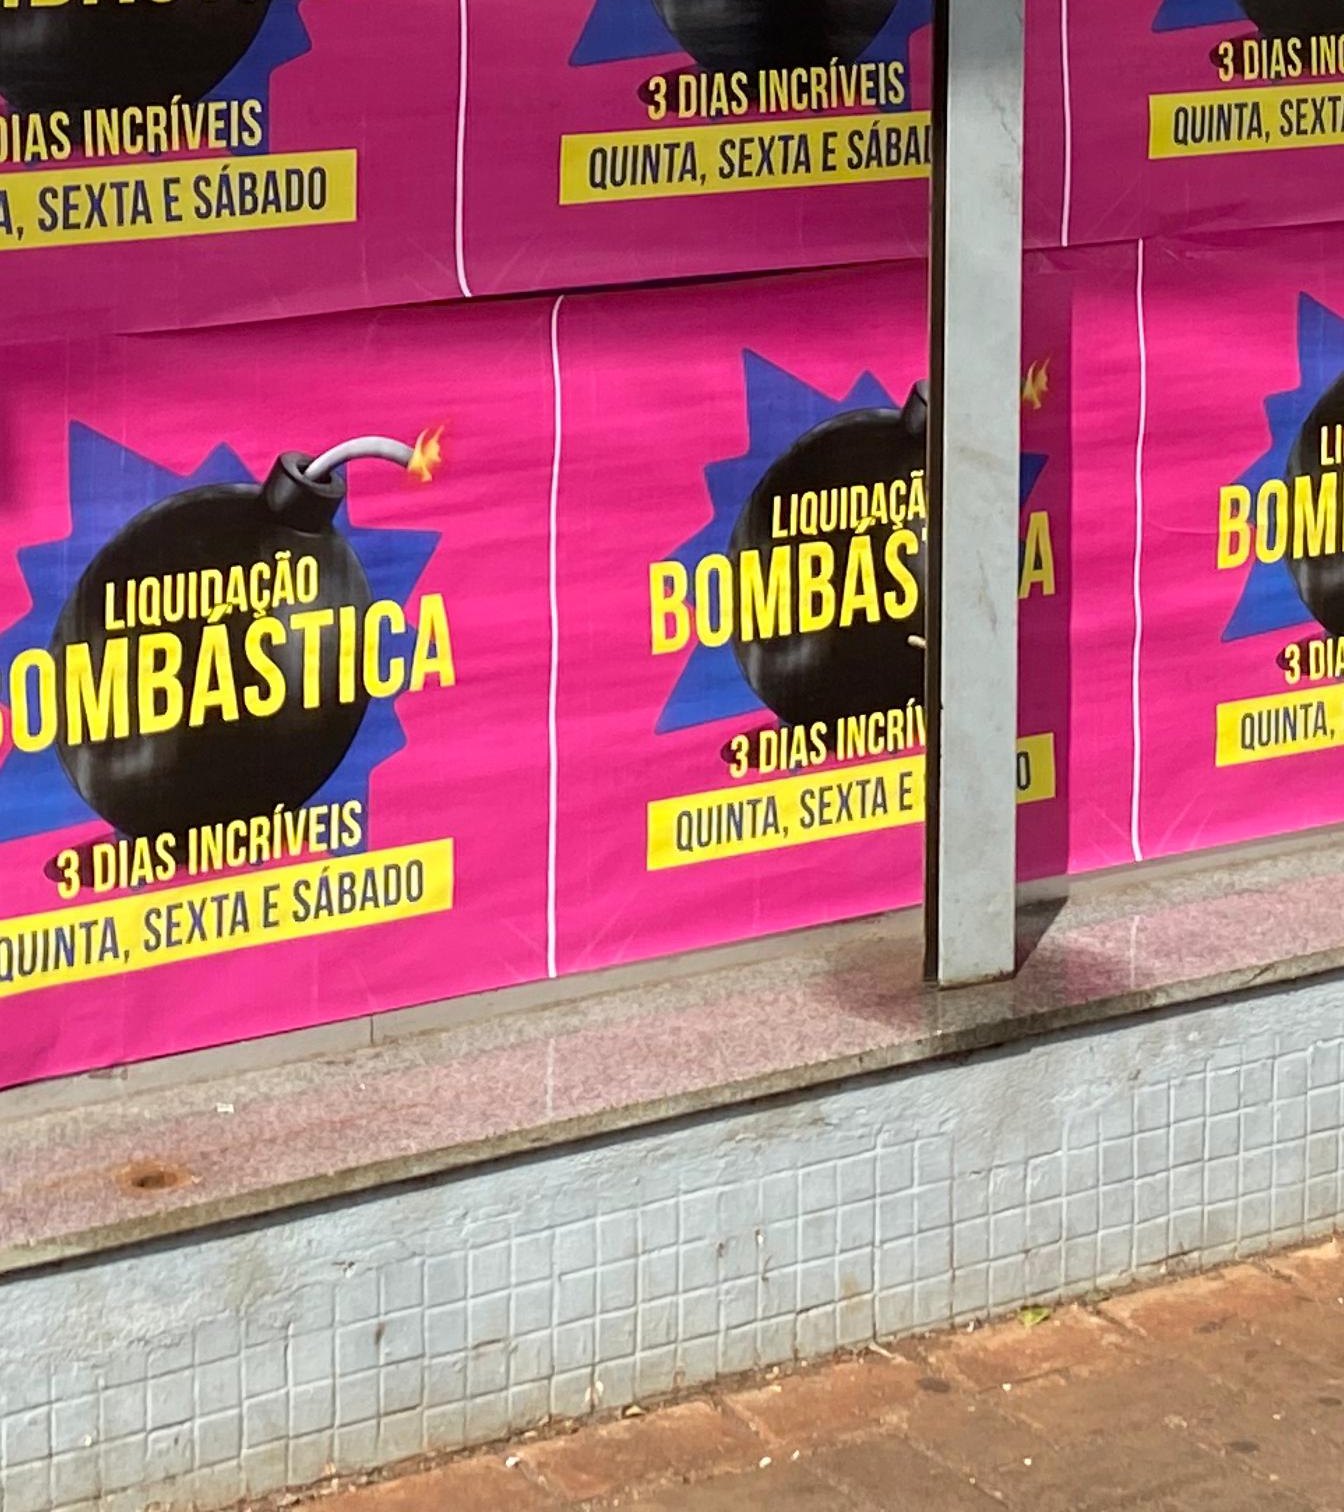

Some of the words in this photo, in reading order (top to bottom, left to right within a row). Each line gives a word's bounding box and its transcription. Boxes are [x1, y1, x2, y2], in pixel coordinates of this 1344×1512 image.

[648, 76, 667, 120] 3
[679, 71, 748, 118] DIAS
[760, 57, 904, 113] INCRÍVEIS
[1218, 41, 1233, 82] 3
[1244, 37, 1302, 81] DIAS
[84, 95, 262, 158] INCRÍVEIS
[589, 141, 706, 190] QUINTA,
[719, 134, 811, 179] SEXTA
[822, 131, 837, 172] E
[848, 120, 931, 169] SÁBA
[1173, 101, 1270, 146] QUINTA,
[38, 179, 152, 233] SEXTA
[165, 176, 182, 222] E
[194, 165, 326, 220] SÁBADO
[772, 470, 926, 539] LIQUIDAÇÃ
[105, 551, 318, 631] LIQUIDAÇÃO
[649, 511, 1056, 655] BOMBÁSA
[1284, 644, 1300, 685] 3
[730, 735, 749, 778] 3
[759, 721, 827, 774] DIAS
[1241, 701, 1335, 751] QUINTA,
[676, 795, 788, 851] QUINTA,
[800, 776, 887, 828] SEXTA
[899, 771, 913, 810] E
[57, 850, 80, 900] 3
[94, 833, 177, 894] DIAS
[188, 800, 363, 876] INCRÍVEIS
[144, 892, 250, 952] SEXTA
[263, 883, 279, 928] E
[293, 859, 423, 922] SÁBADO
